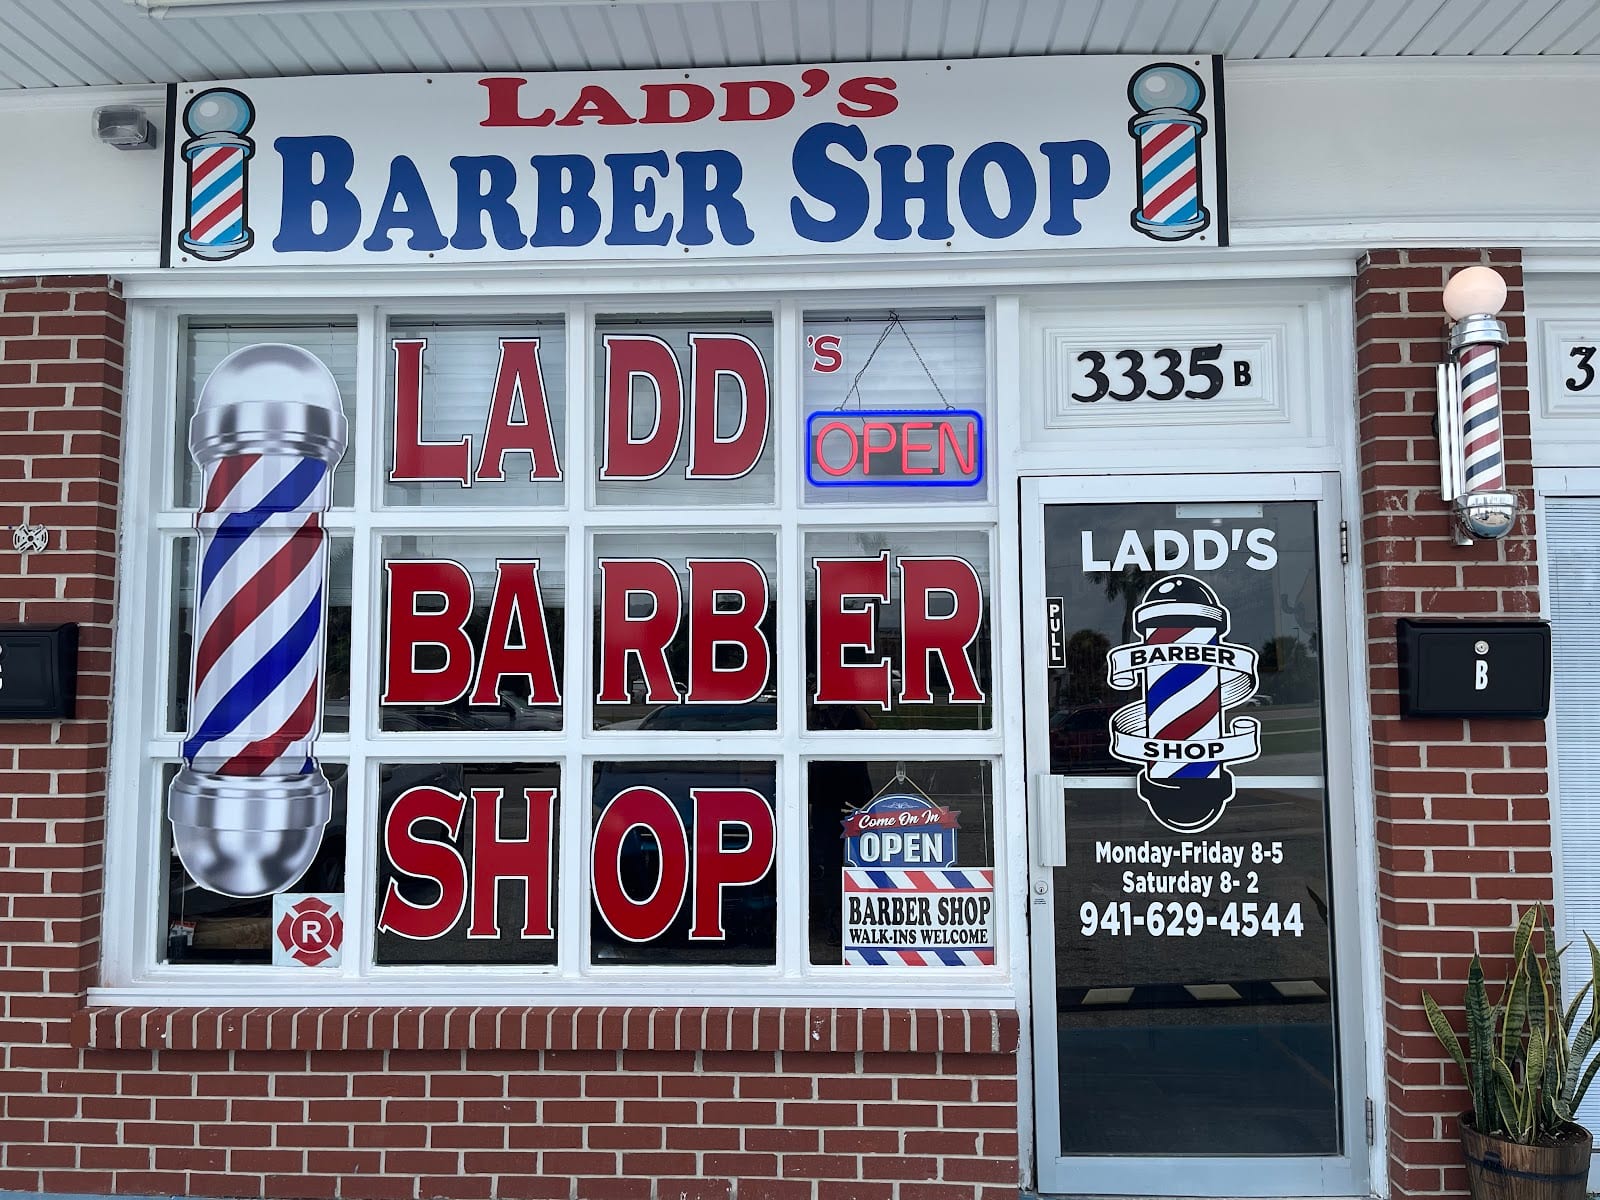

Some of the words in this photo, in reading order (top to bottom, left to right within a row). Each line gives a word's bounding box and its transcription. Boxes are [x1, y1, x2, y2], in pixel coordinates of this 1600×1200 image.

[478, 69, 899, 127] LADD'S
[272, 134, 755, 252] BARBER
[790, 122, 1111, 243] SHOP
[1071, 343, 1224, 403] 3335
[1233, 360, 1252, 387] B
[1565, 346, 1597, 392] 3
[816, 421, 975, 476] OPEN
[1081, 528, 1278, 572] LADD'S
[380, 550, 985, 711] BARBER
[1049, 604, 1062, 661] PULL
[1130, 646, 1236, 667] BARBER
[1475, 659, 1489, 690] B
[1143, 741, 1225, 759] SHOP
[858, 814, 896, 830] Come
[901, 811, 918, 827] On
[922, 809, 940, 824] In
[378, 785, 777, 943] SHOP
[859, 832, 943, 863] OPEN
[1095, 841, 1244, 867] Monday-Friday
[1251, 842, 1283, 865] 8-5
[1122, 870, 1213, 897] Saturday
[849, 896, 932, 926] BARBER
[937, 896, 991, 926] SHOP
[1079, 900, 1304, 937] 941-629-4544
[302, 920, 323, 944] R
[850, 929, 917, 945] WALK-INS
[917, 928, 988, 945] WELCOME
